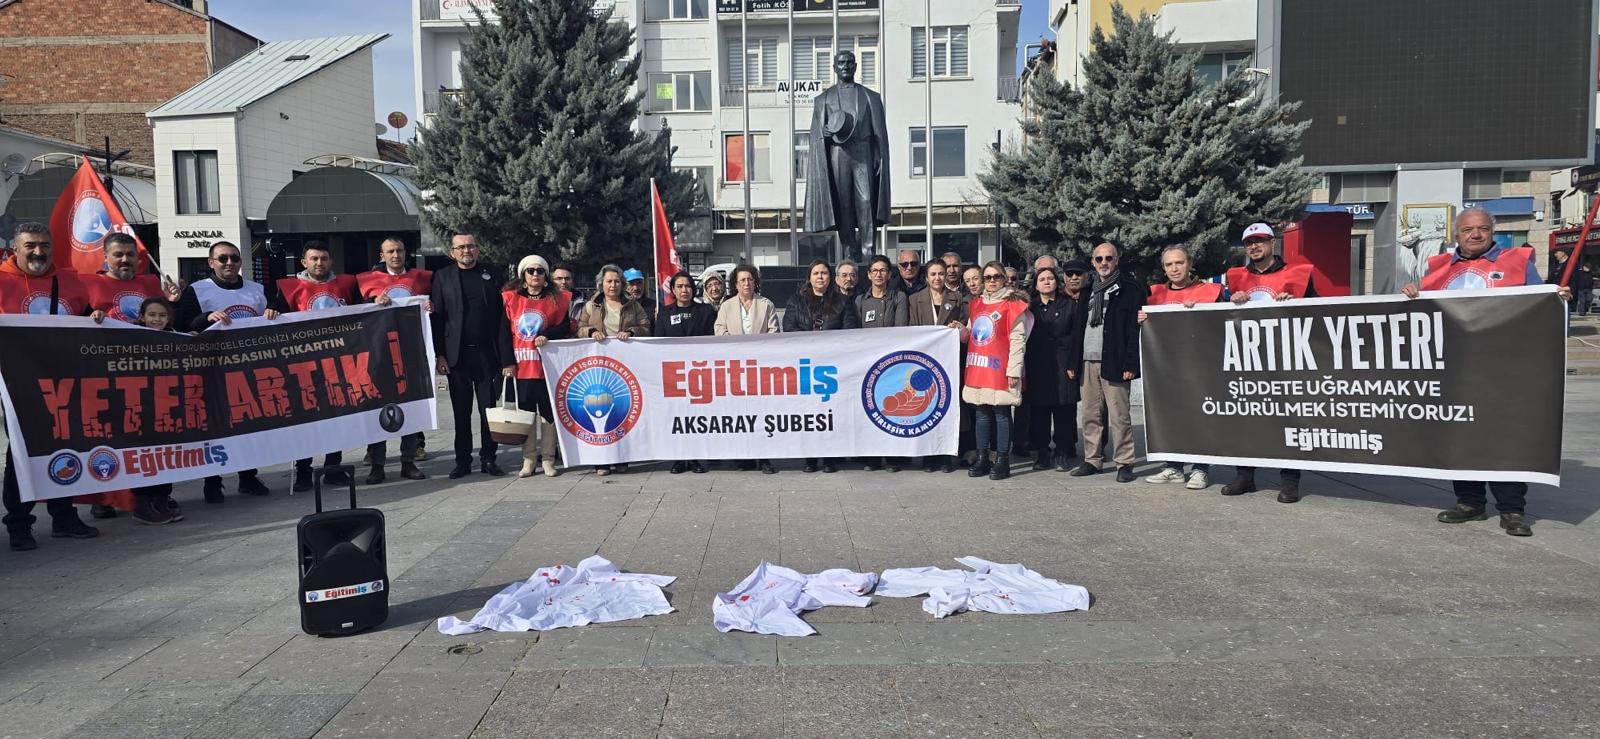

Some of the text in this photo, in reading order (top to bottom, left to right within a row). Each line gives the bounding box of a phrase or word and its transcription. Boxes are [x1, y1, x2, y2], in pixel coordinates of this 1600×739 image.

[778, 81, 821, 92] AVUKAT
[174, 230, 225, 239] ASLANLAR
[80, 343, 174, 355] ÖĞRETMENLERİ
[220, 332, 288, 350] GELECEĞİNİZİ
[291, 321, 364, 340] KORURSUNUZ
[1223, 311, 1445, 372] ARTIK YETER!
[107, 357, 179, 372] EĞİTİMDE
[217, 347, 277, 366] YASASINI
[281, 337, 345, 360] ÇIKARTIN
[662, 358, 838, 404] Eğitimiş
[1228, 375, 1441, 399] ŞİDDETE UĞRAMAK VE
[37, 374, 208, 441] YETER
[223, 351, 383, 429] ARTIK
[1202, 397, 1474, 422] ÖLDÜRÜLMEK İSTEMİYORUZ!
[672, 409, 834, 438] AKSARAY ŞUBESİ
[871, 411, 905, 435] BİRLEŞİK
[1284, 427, 1383, 454] Eğitimiş
[122, 442, 229, 478] Eğitimiş
[325, 586, 367, 599] Eğitimiş
